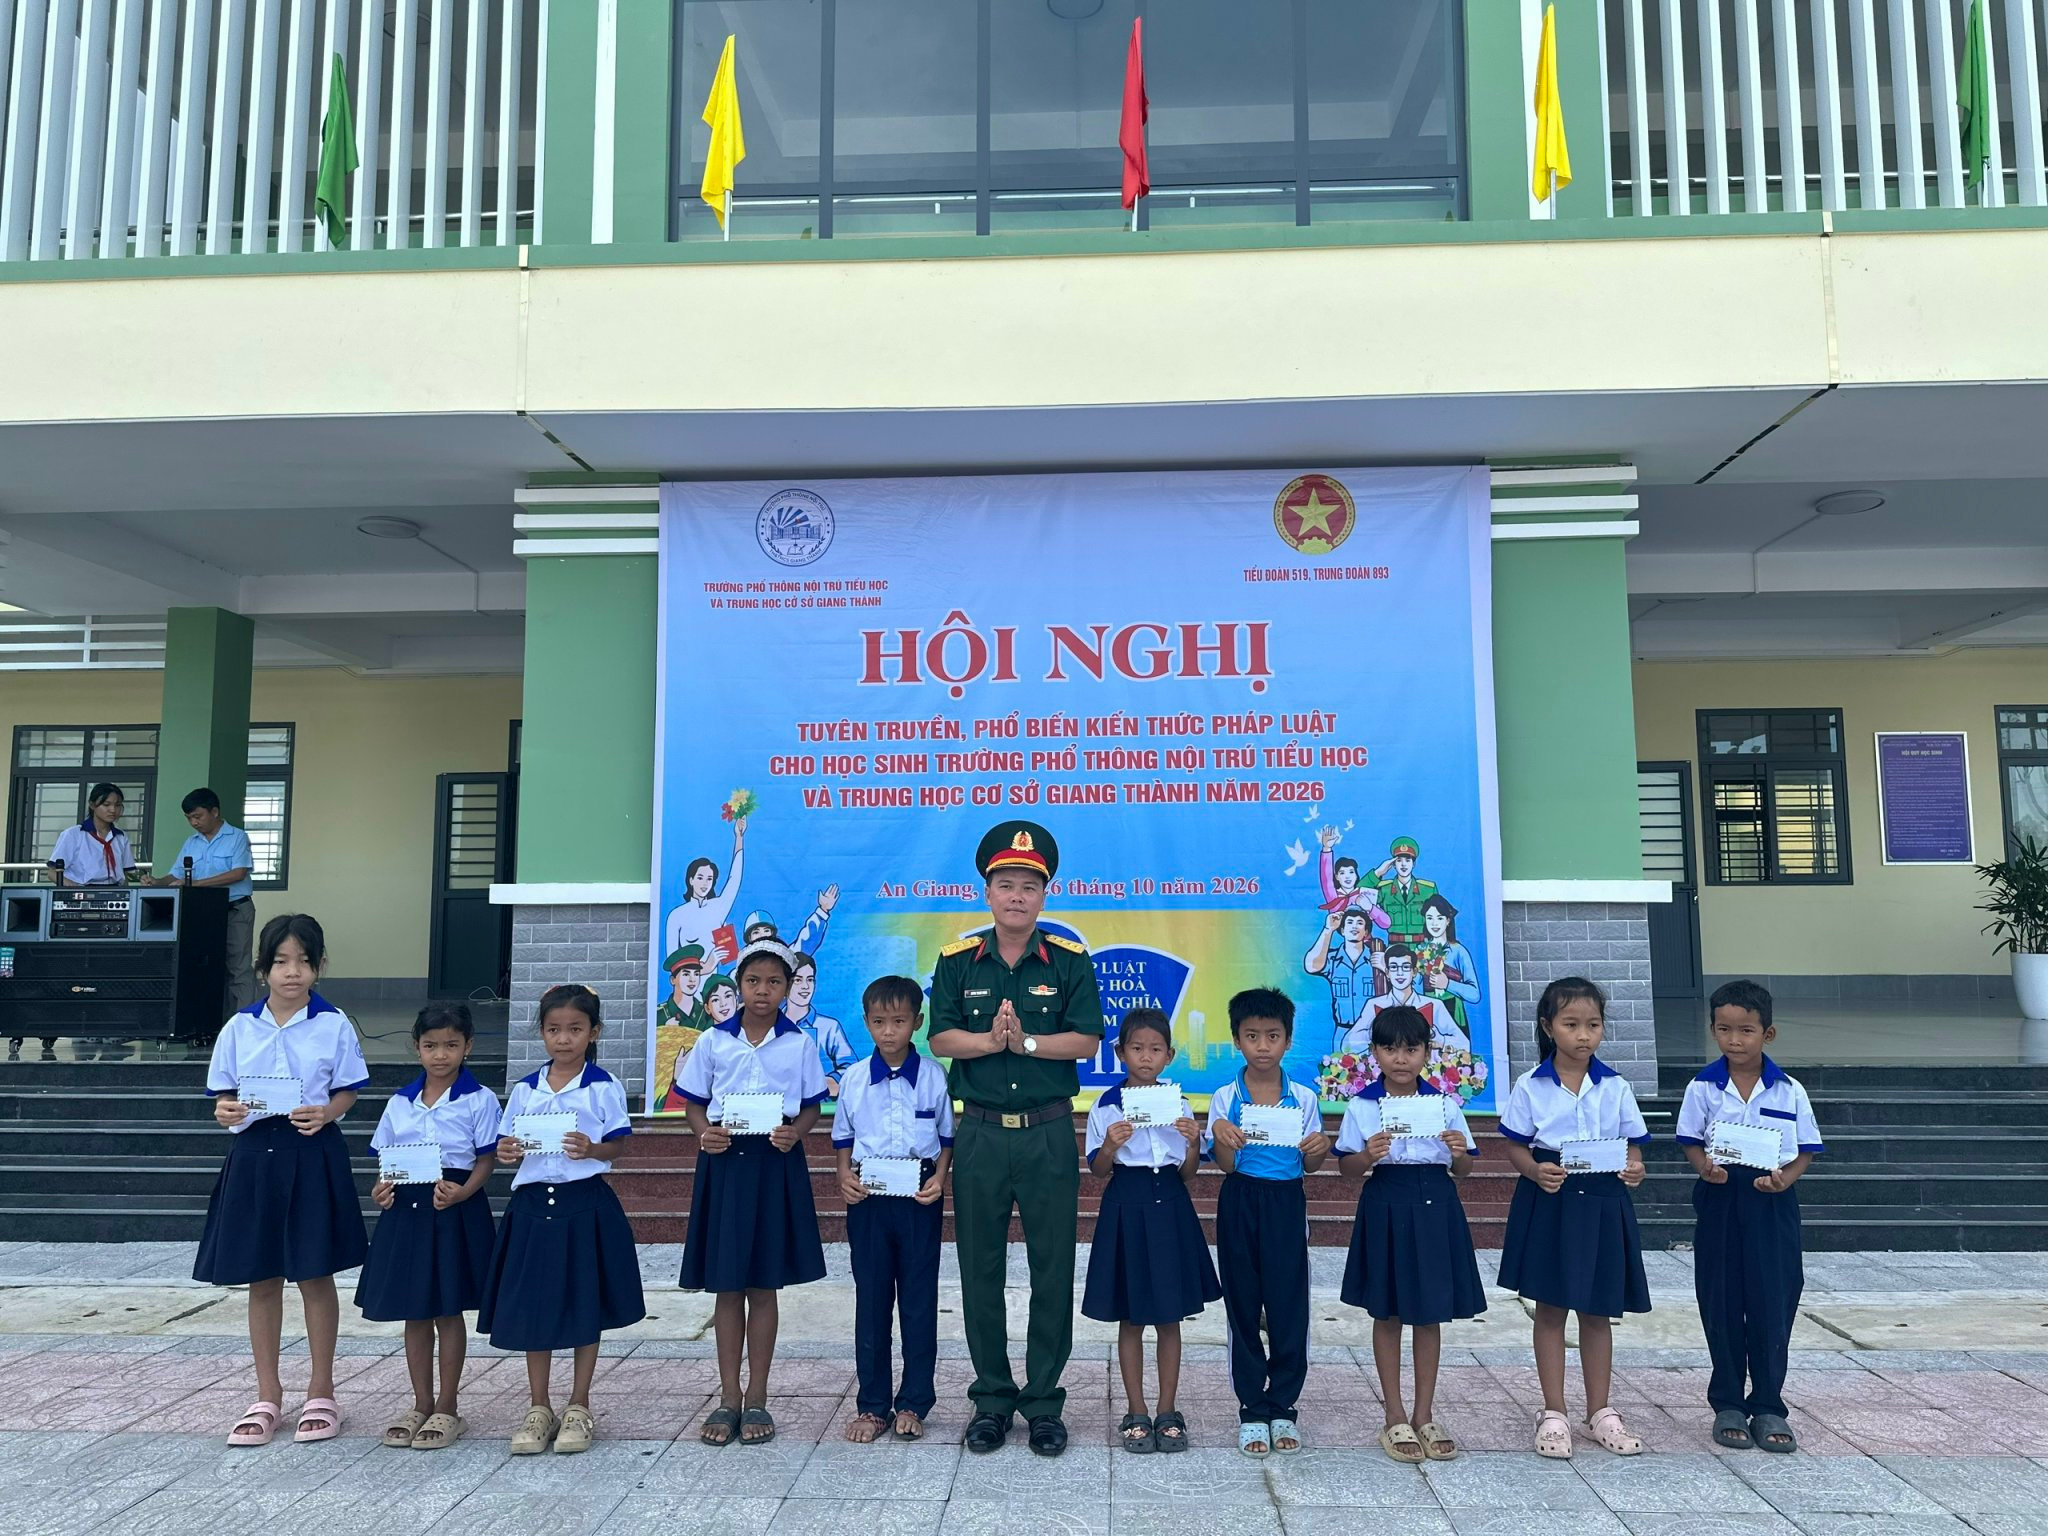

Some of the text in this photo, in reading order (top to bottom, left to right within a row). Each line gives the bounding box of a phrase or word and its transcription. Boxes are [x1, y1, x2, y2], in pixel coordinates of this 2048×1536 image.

[1243, 565, 1389, 582] TIỂU ĐOÀN 519, TRUNG ĐOÀN 893
[704, 577, 888, 593] TRƯỜNG PHỔ THÔNG NỘI TRÚ TIỂU HỌC
[711, 597, 723, 608] VÀ
[726, 599, 758, 608] TRUNG
[762, 599, 781, 610] HỌC
[801, 595, 813, 608] SỞ
[817, 597, 846, 607] GIANG
[850, 596, 881, 607] THÀNH
[860, 609, 1272, 699] HỘI NGHỊ
[797, 709, 1337, 743] TUYÊN TRUYỀN, PHỔ BIẾN KIẾN THỨC PHÁP LUẬT
[769, 740, 1369, 779] CHO HỌC SINH TRƯỜNG PHỔ THÔNG NỘI TRÚ TIỂU HỌC
[803, 778, 1324, 812] VÀ TRUNG HỌC CƠ SỞ GIANG THÀNH NĂM 2026
[877, 880, 908, 899] An
[912, 879, 979, 900] Giang,
[1067, 878, 1126, 899] tháng
[1132, 878, 1156, 896] 10
[1160, 879, 1206, 895] năm
[1210, 876, 1260, 895] 2026
[1102, 960, 1146, 977] LUẬT
[1109, 976, 1146, 991] HOÀ
[1107, 994, 1162, 1009] NGHĨA
